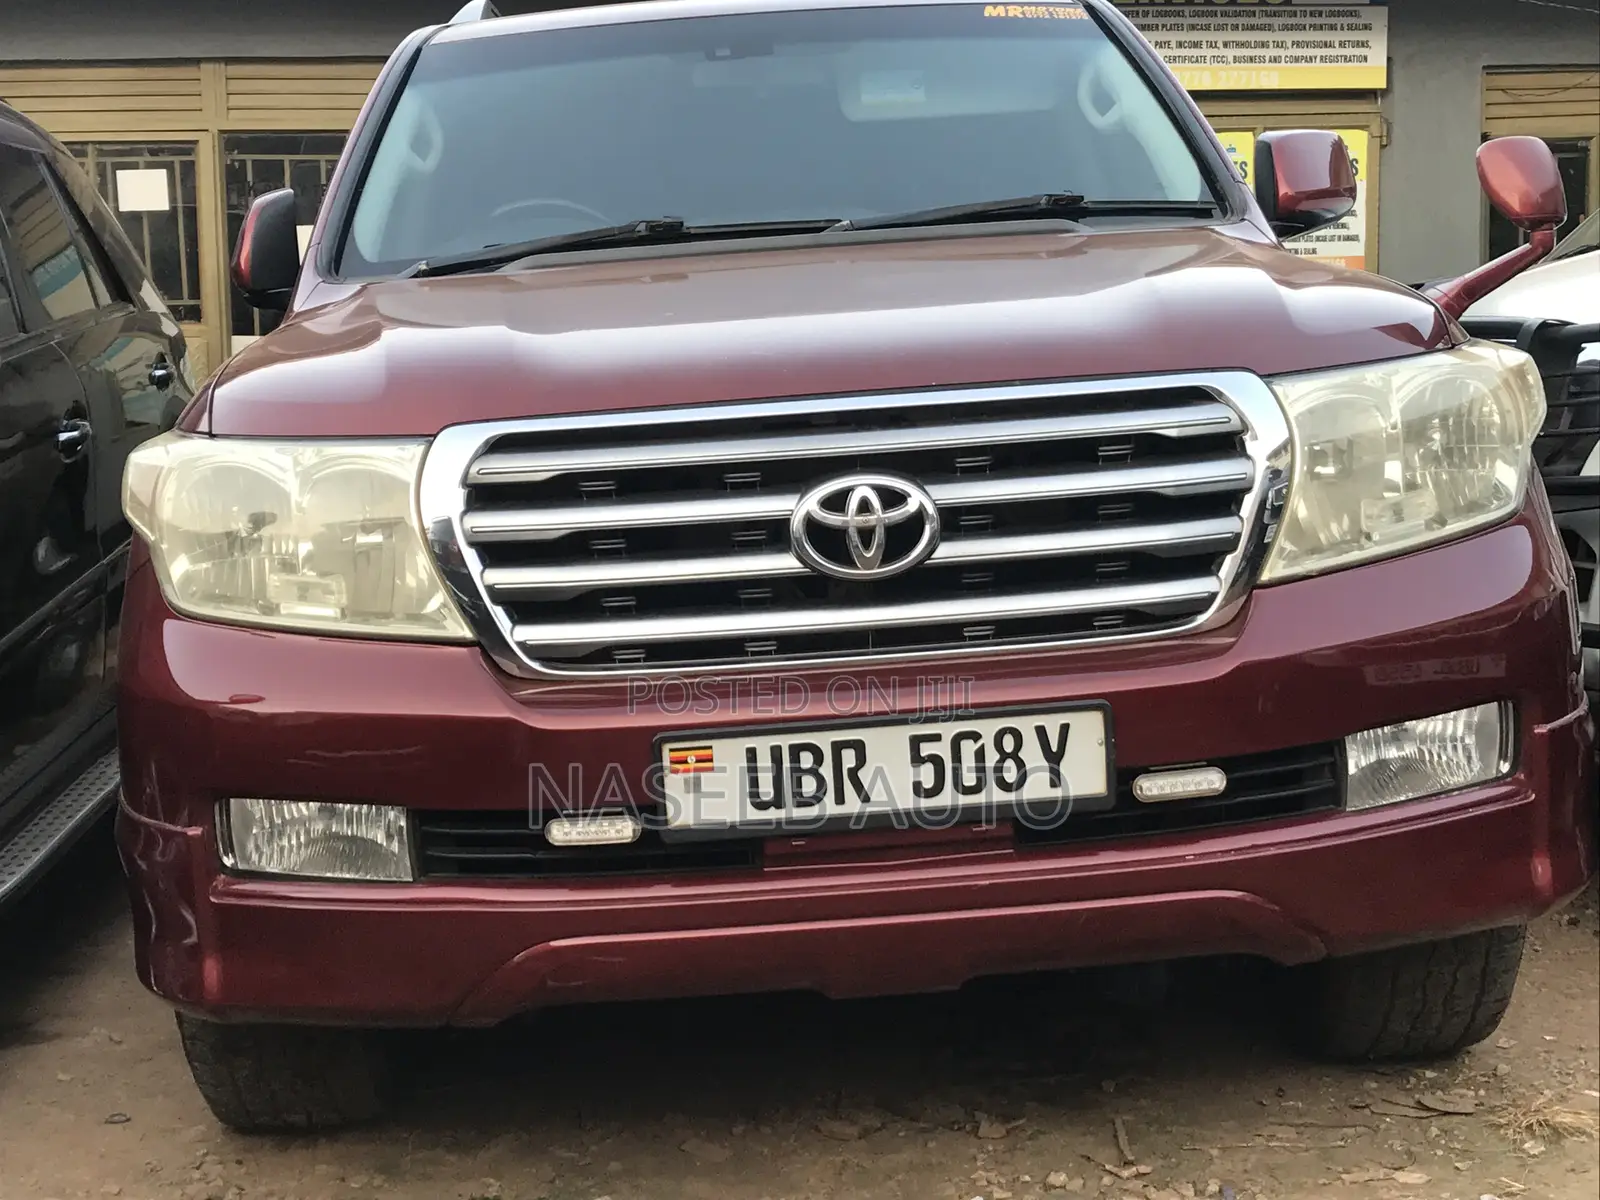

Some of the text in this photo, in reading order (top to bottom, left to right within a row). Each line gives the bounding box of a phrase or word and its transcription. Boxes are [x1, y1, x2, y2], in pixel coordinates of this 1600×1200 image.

[1189, 9, 1219, 18] LOGBOOK
[1220, 9, 1257, 18] VALIDATION
[1299, 9, 1308, 18] TO
[1309, 9, 1324, 18] NEW
[1161, 23, 1185, 32] PLATES
[1186, 23, 1212, 33] (INCASE
[1213, 23, 1229, 32] LOST
[1230, 23, 1240, 32] OR
[1278, 23, 1307, 32] LOGBOOK
[1308, 23, 1338, 32] PRINTING
[1346, 23, 1373, 32] SEALING
[1175, 40, 1203, 49] INCOME
[1222, 40, 1270, 49] WITHHOLDING
[1291, 40, 1337, 49] PROVISIONAL
[1338, 40, 1372, 50] RETURNS,
[1163, 55, 1208, 64] CERTIFICATE
[1232, 55, 1267, 64] BUSINESS
[1268, 55, 1282, 64] AND
[1284, 55, 1318, 64] COMPANY
[1319, 55, 1368, 64] REGISTRATION
[745, 721, 1071, 811] UBR 508Y
